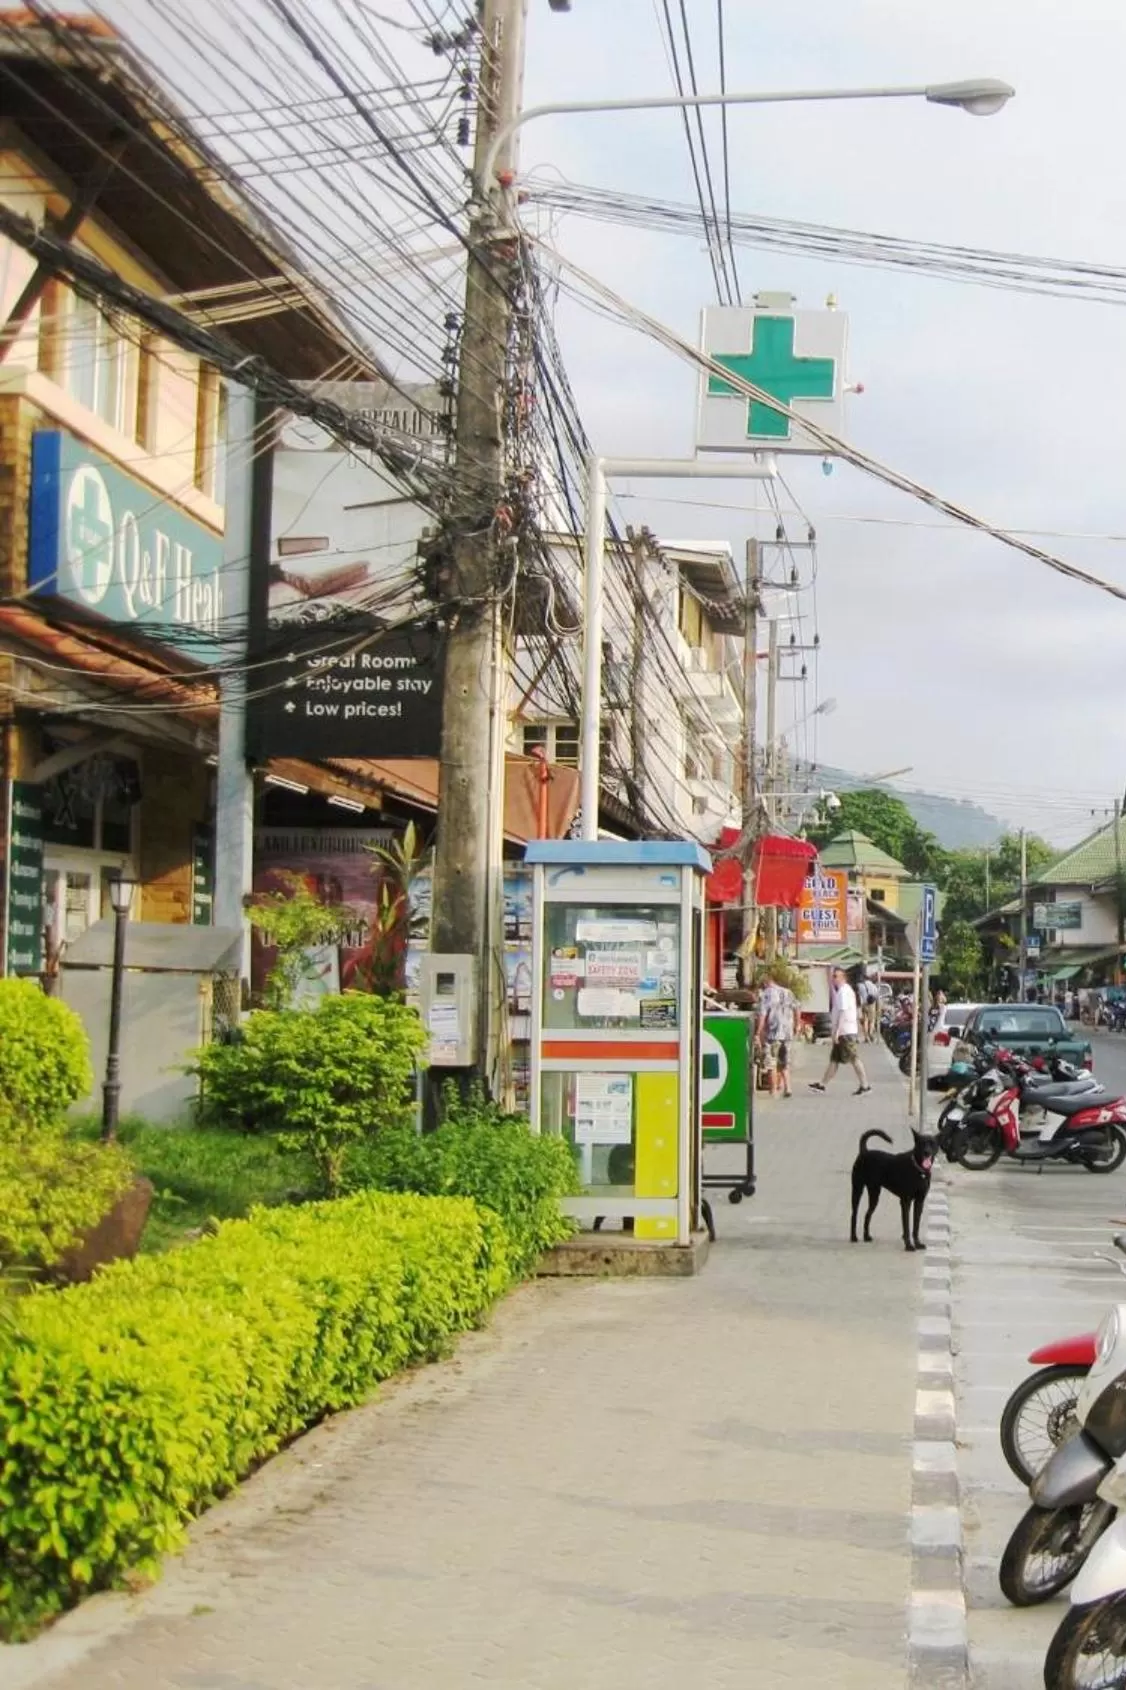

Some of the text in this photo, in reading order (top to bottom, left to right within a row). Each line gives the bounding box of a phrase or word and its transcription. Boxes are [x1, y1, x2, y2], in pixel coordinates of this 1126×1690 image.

[306, 675, 432, 695] Enjoyable stay
[306, 701, 402, 719] Low prices!
